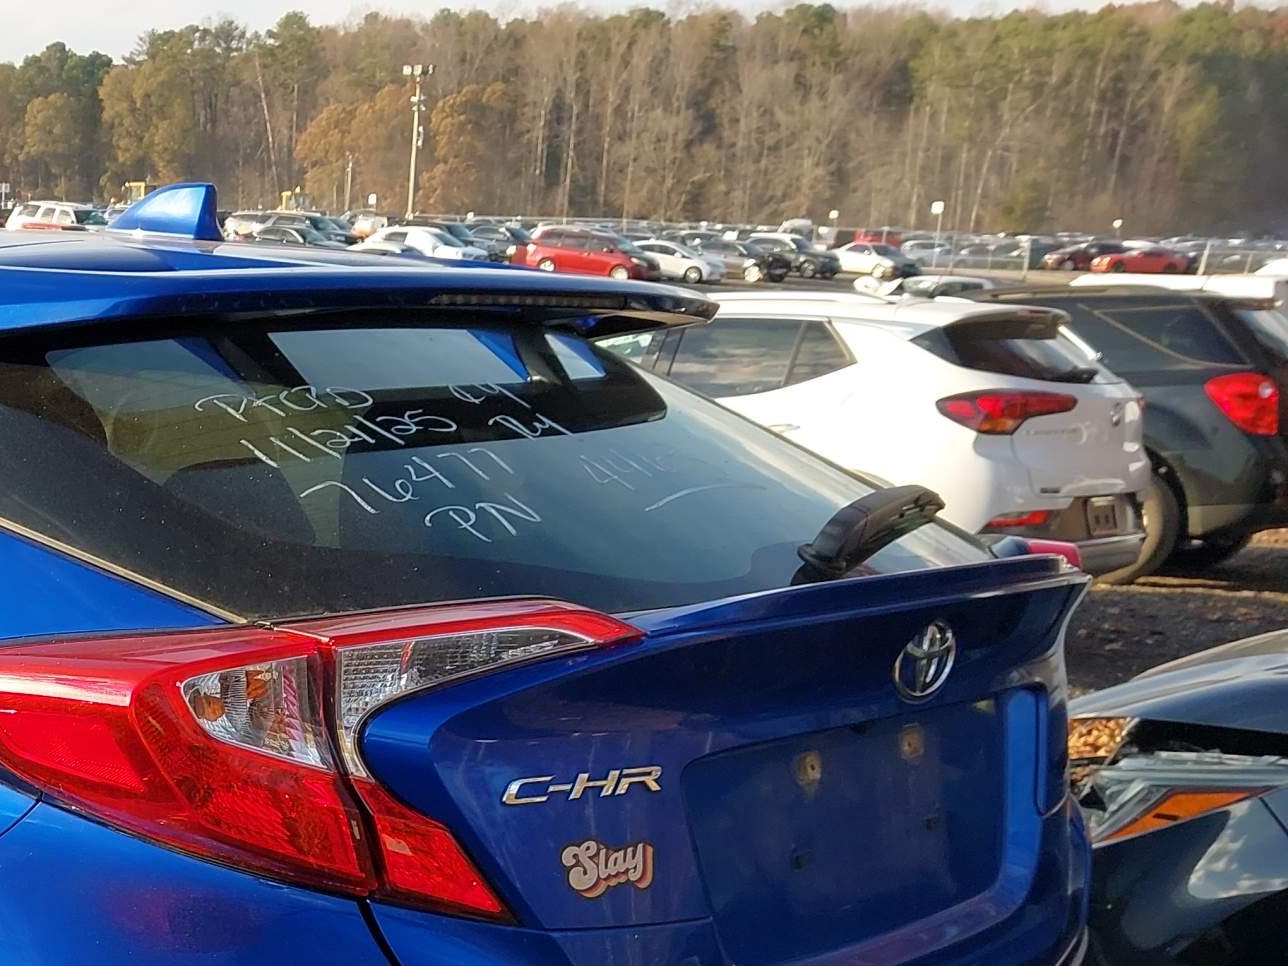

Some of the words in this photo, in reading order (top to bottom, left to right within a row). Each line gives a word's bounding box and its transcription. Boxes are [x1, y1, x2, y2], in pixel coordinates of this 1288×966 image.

[299, 447, 515, 515] 76477
[501, 765, 663, 806] C-HR
[561, 840, 654, 898] Slay
